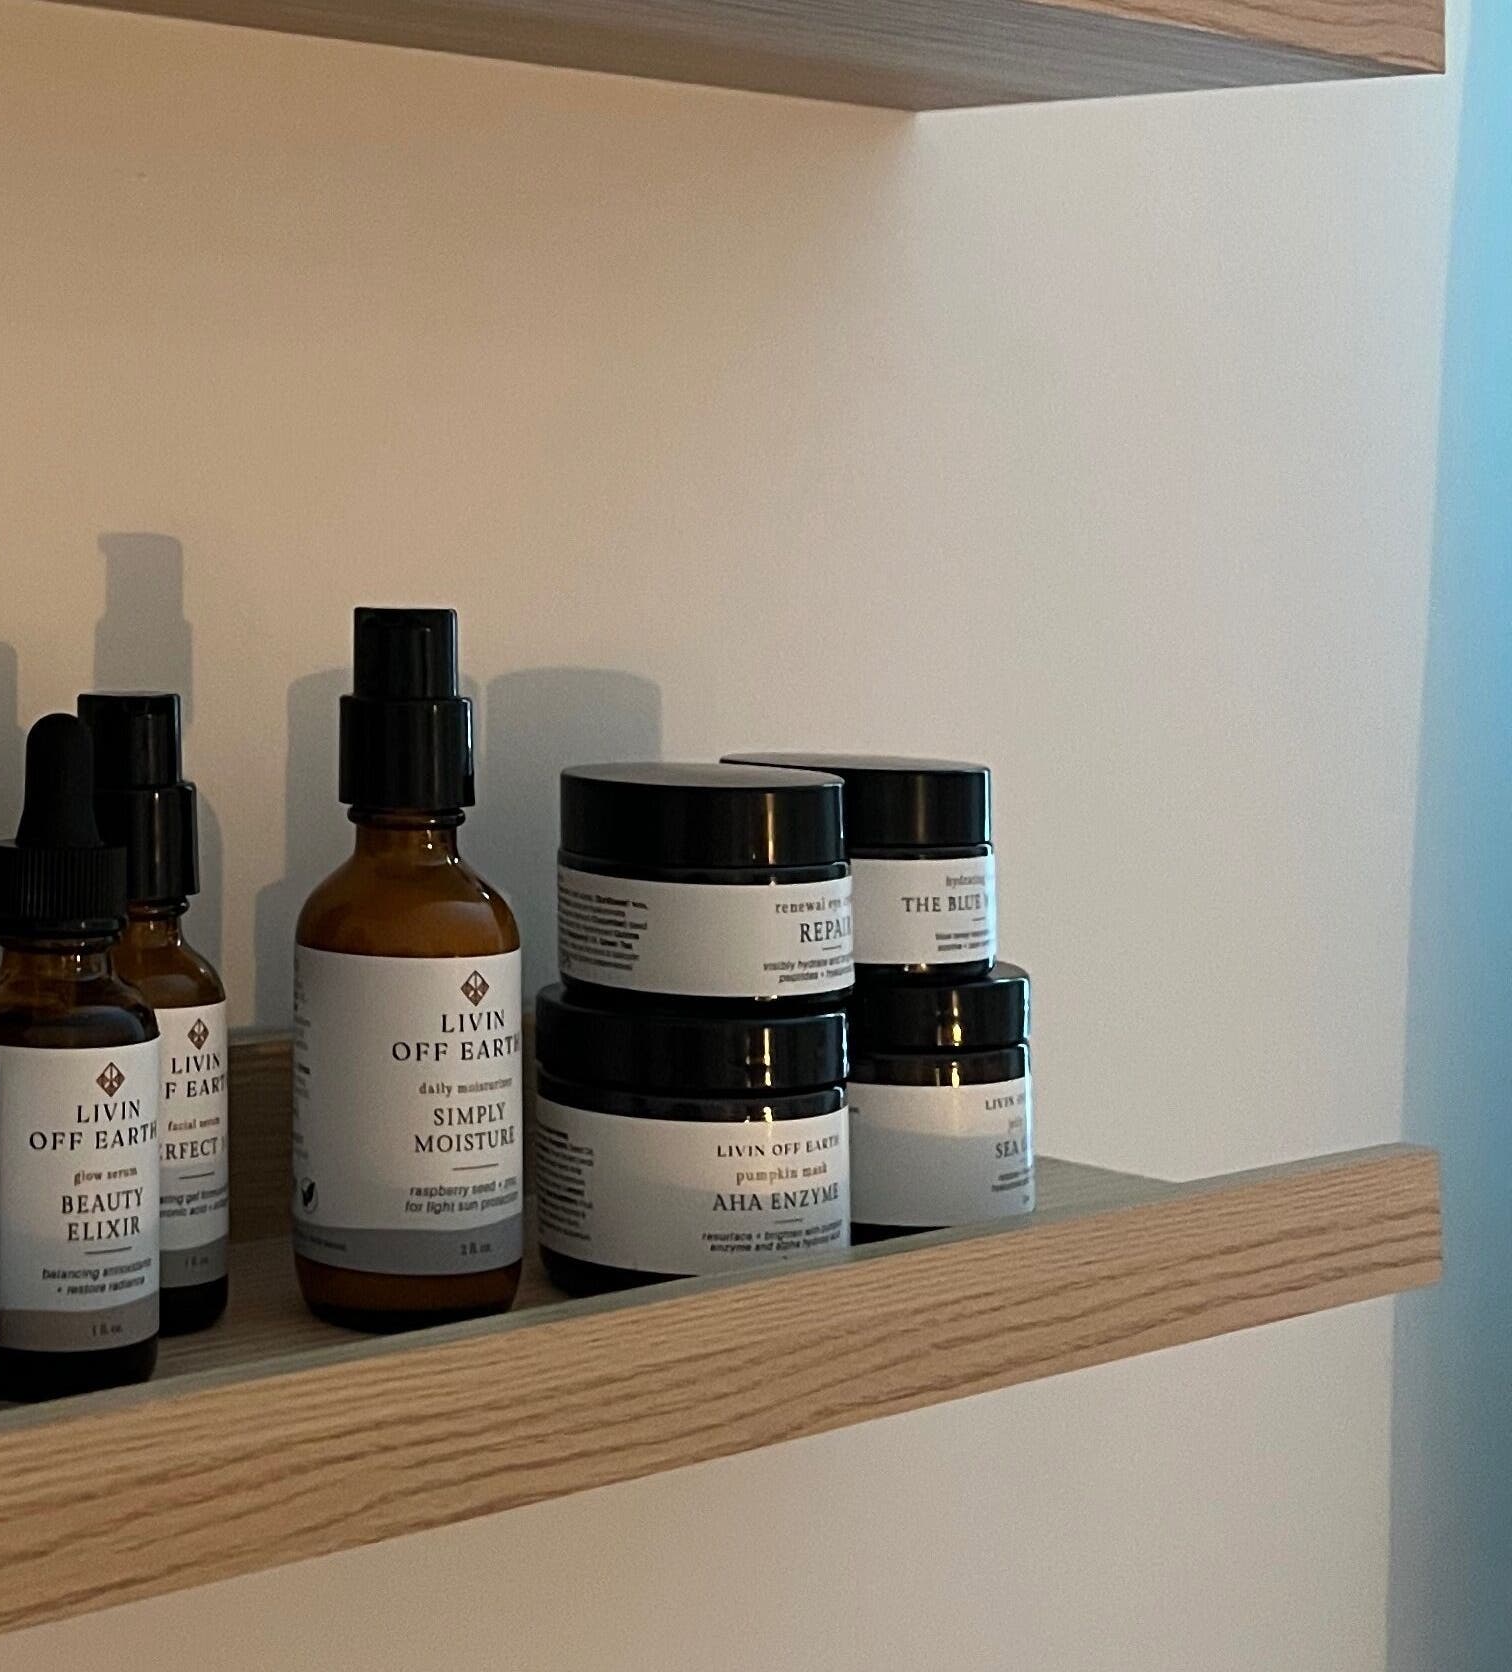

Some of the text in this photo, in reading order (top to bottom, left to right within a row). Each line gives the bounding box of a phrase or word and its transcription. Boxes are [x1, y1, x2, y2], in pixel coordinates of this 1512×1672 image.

[774, 897, 826, 914] renewal
[900, 896, 942, 913] THE
[947, 893, 981, 912] BLUE
[799, 914, 852, 944] REPAI
[441, 1009, 505, 1033] LIVIN
[391, 1041, 449, 1062] OFF
[171, 1052, 222, 1074] LIVIN
[187, 1073, 227, 1098] EART
[418, 1081, 453, 1098] daily
[76, 1099, 140, 1124] LIVIN
[984, 1095, 1015, 1111] LIVIN
[432, 1101, 506, 1127] SIMPLY
[167, 1117, 197, 1132] facial
[29, 1119, 157, 1151] OFF EARTH
[414, 1125, 515, 1153] MOISTURE
[717, 1144, 766, 1158] LIVIN
[771, 1142, 801, 1156] OFF
[994, 1140, 1020, 1160] SEA
[73, 1167, 138, 1187] glow serum
[735, 1167, 799, 1186] pumpkin
[61, 1186, 144, 1215] BEAUTY
[408, 1185, 471, 1198] raspberry
[712, 1182, 839, 1212] AHA ENZYME
[404, 1201, 425, 1213] for
[426, 1200, 456, 1216] light
[457, 1200, 479, 1212] sun
[67, 1215, 141, 1242] ELIXIR
[41, 1267, 101, 1282] balancing
